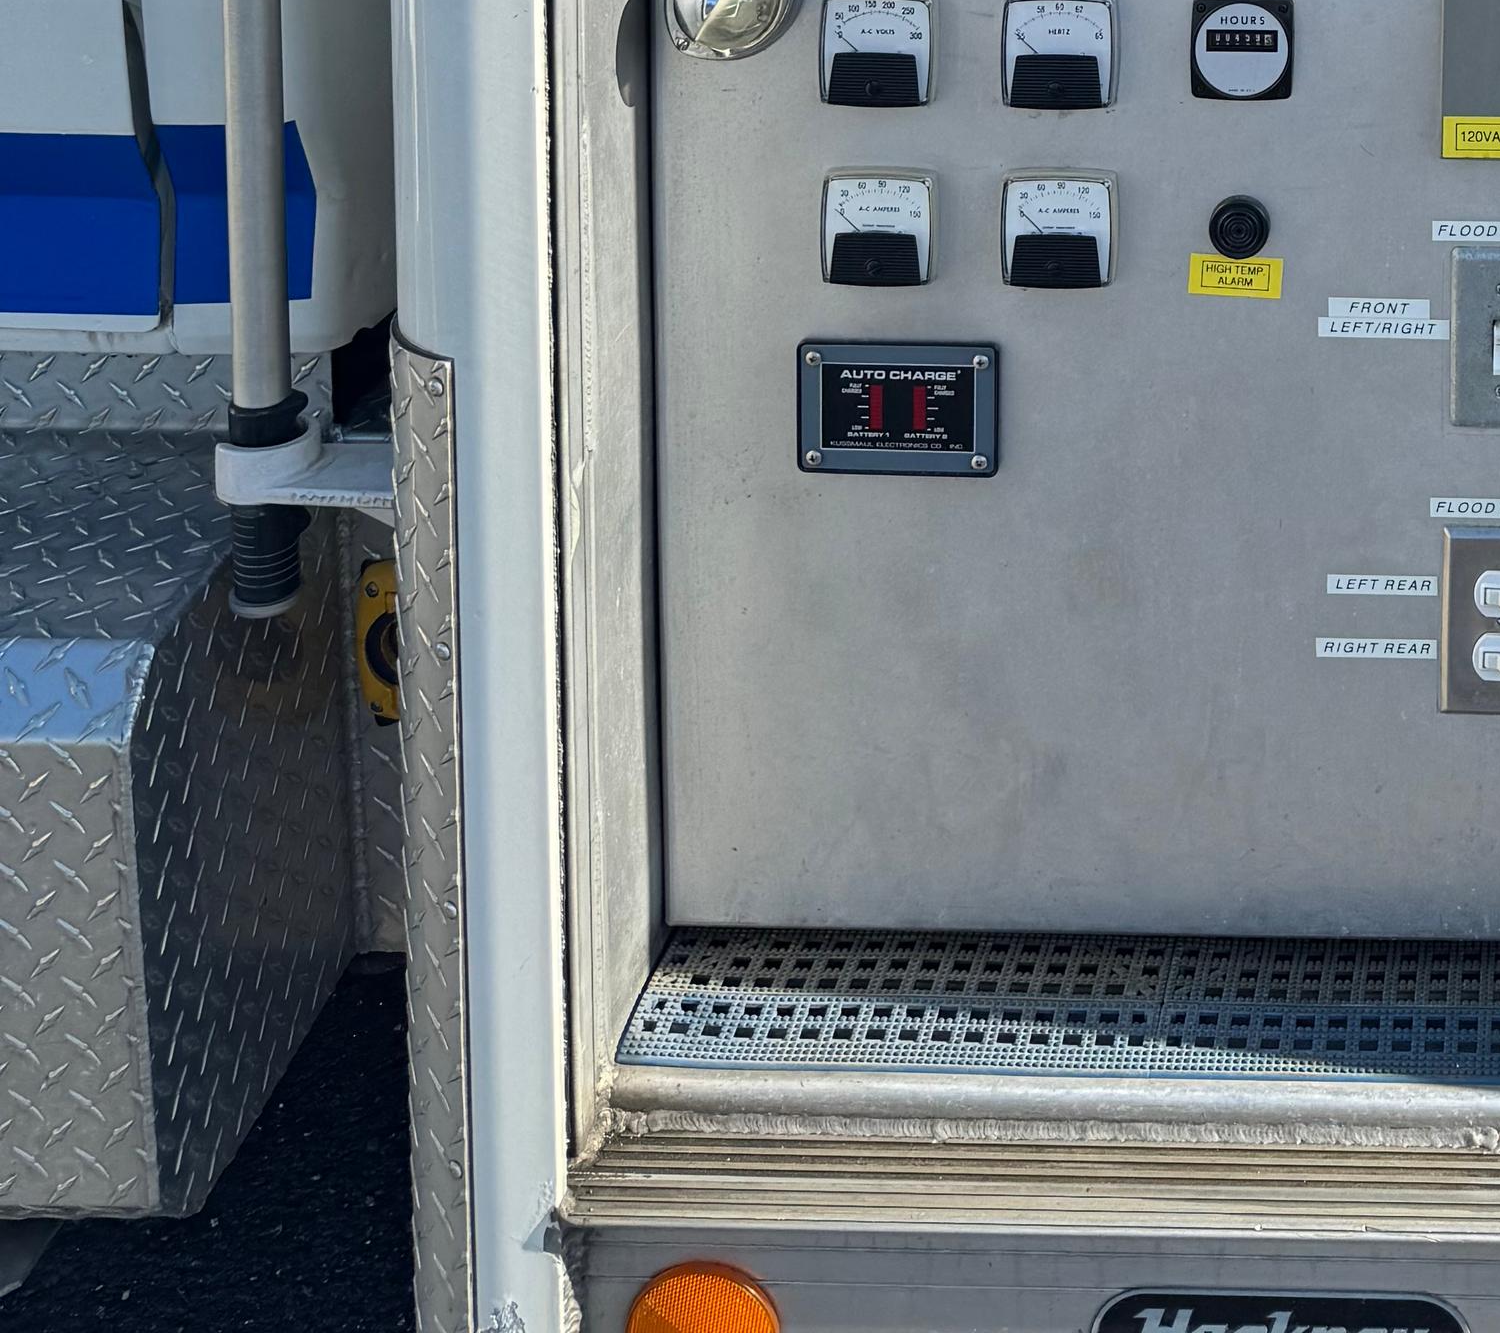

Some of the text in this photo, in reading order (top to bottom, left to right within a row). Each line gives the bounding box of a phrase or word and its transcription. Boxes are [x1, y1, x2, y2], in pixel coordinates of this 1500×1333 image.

[1220, 16, 1265, 25] HOURS
[910, 32, 922, 40] 300
[1438, 225, 1498, 238] FLOOD
[1206, 263, 1233, 275] HIGH
[1217, 276, 1254, 288] ALARM
[1349, 302, 1410, 314] FRONT
[1330, 322, 1438, 336] LEFT/RIGHT
[840, 370, 957, 380] AUTO CHARGE
[1436, 502, 1496, 515] FLOOD
[1335, 578, 1432, 592] LEFT REAR
[1323, 642, 1432, 656] RIGHT REAR
